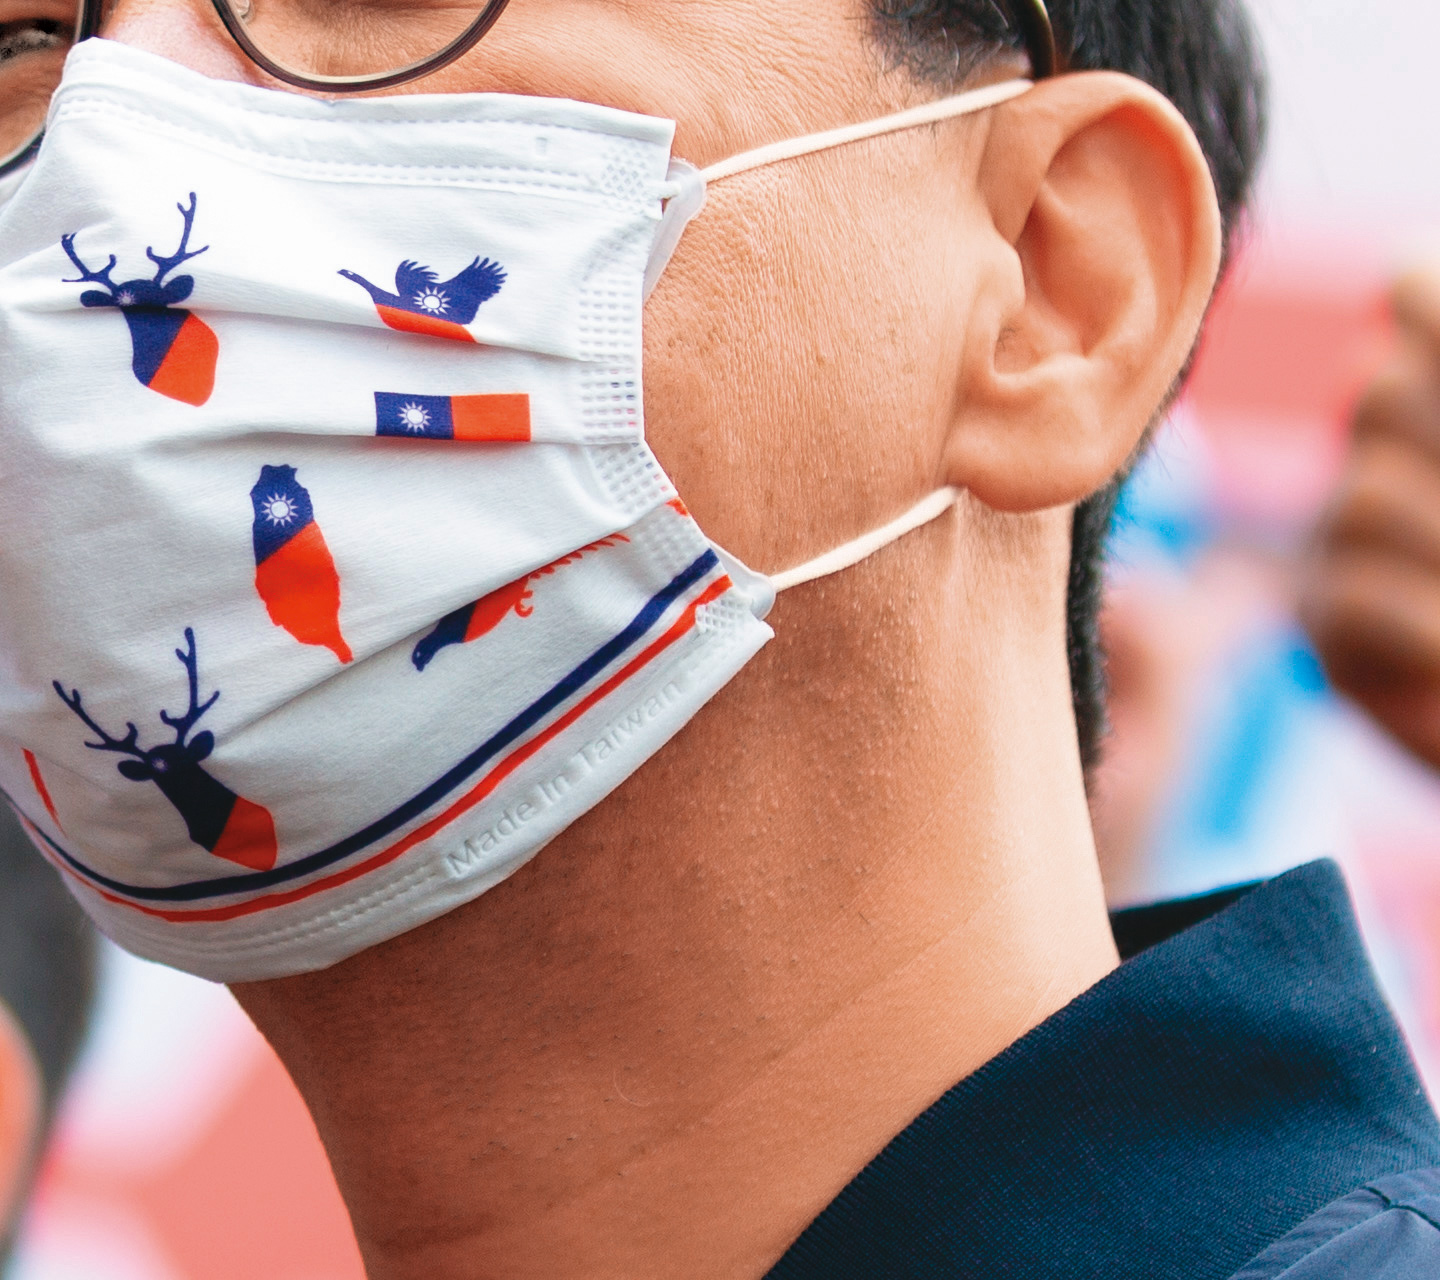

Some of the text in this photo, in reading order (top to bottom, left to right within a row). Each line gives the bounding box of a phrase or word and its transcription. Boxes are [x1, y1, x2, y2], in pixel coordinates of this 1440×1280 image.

[445, 680, 683, 875] Made In Taiwan
